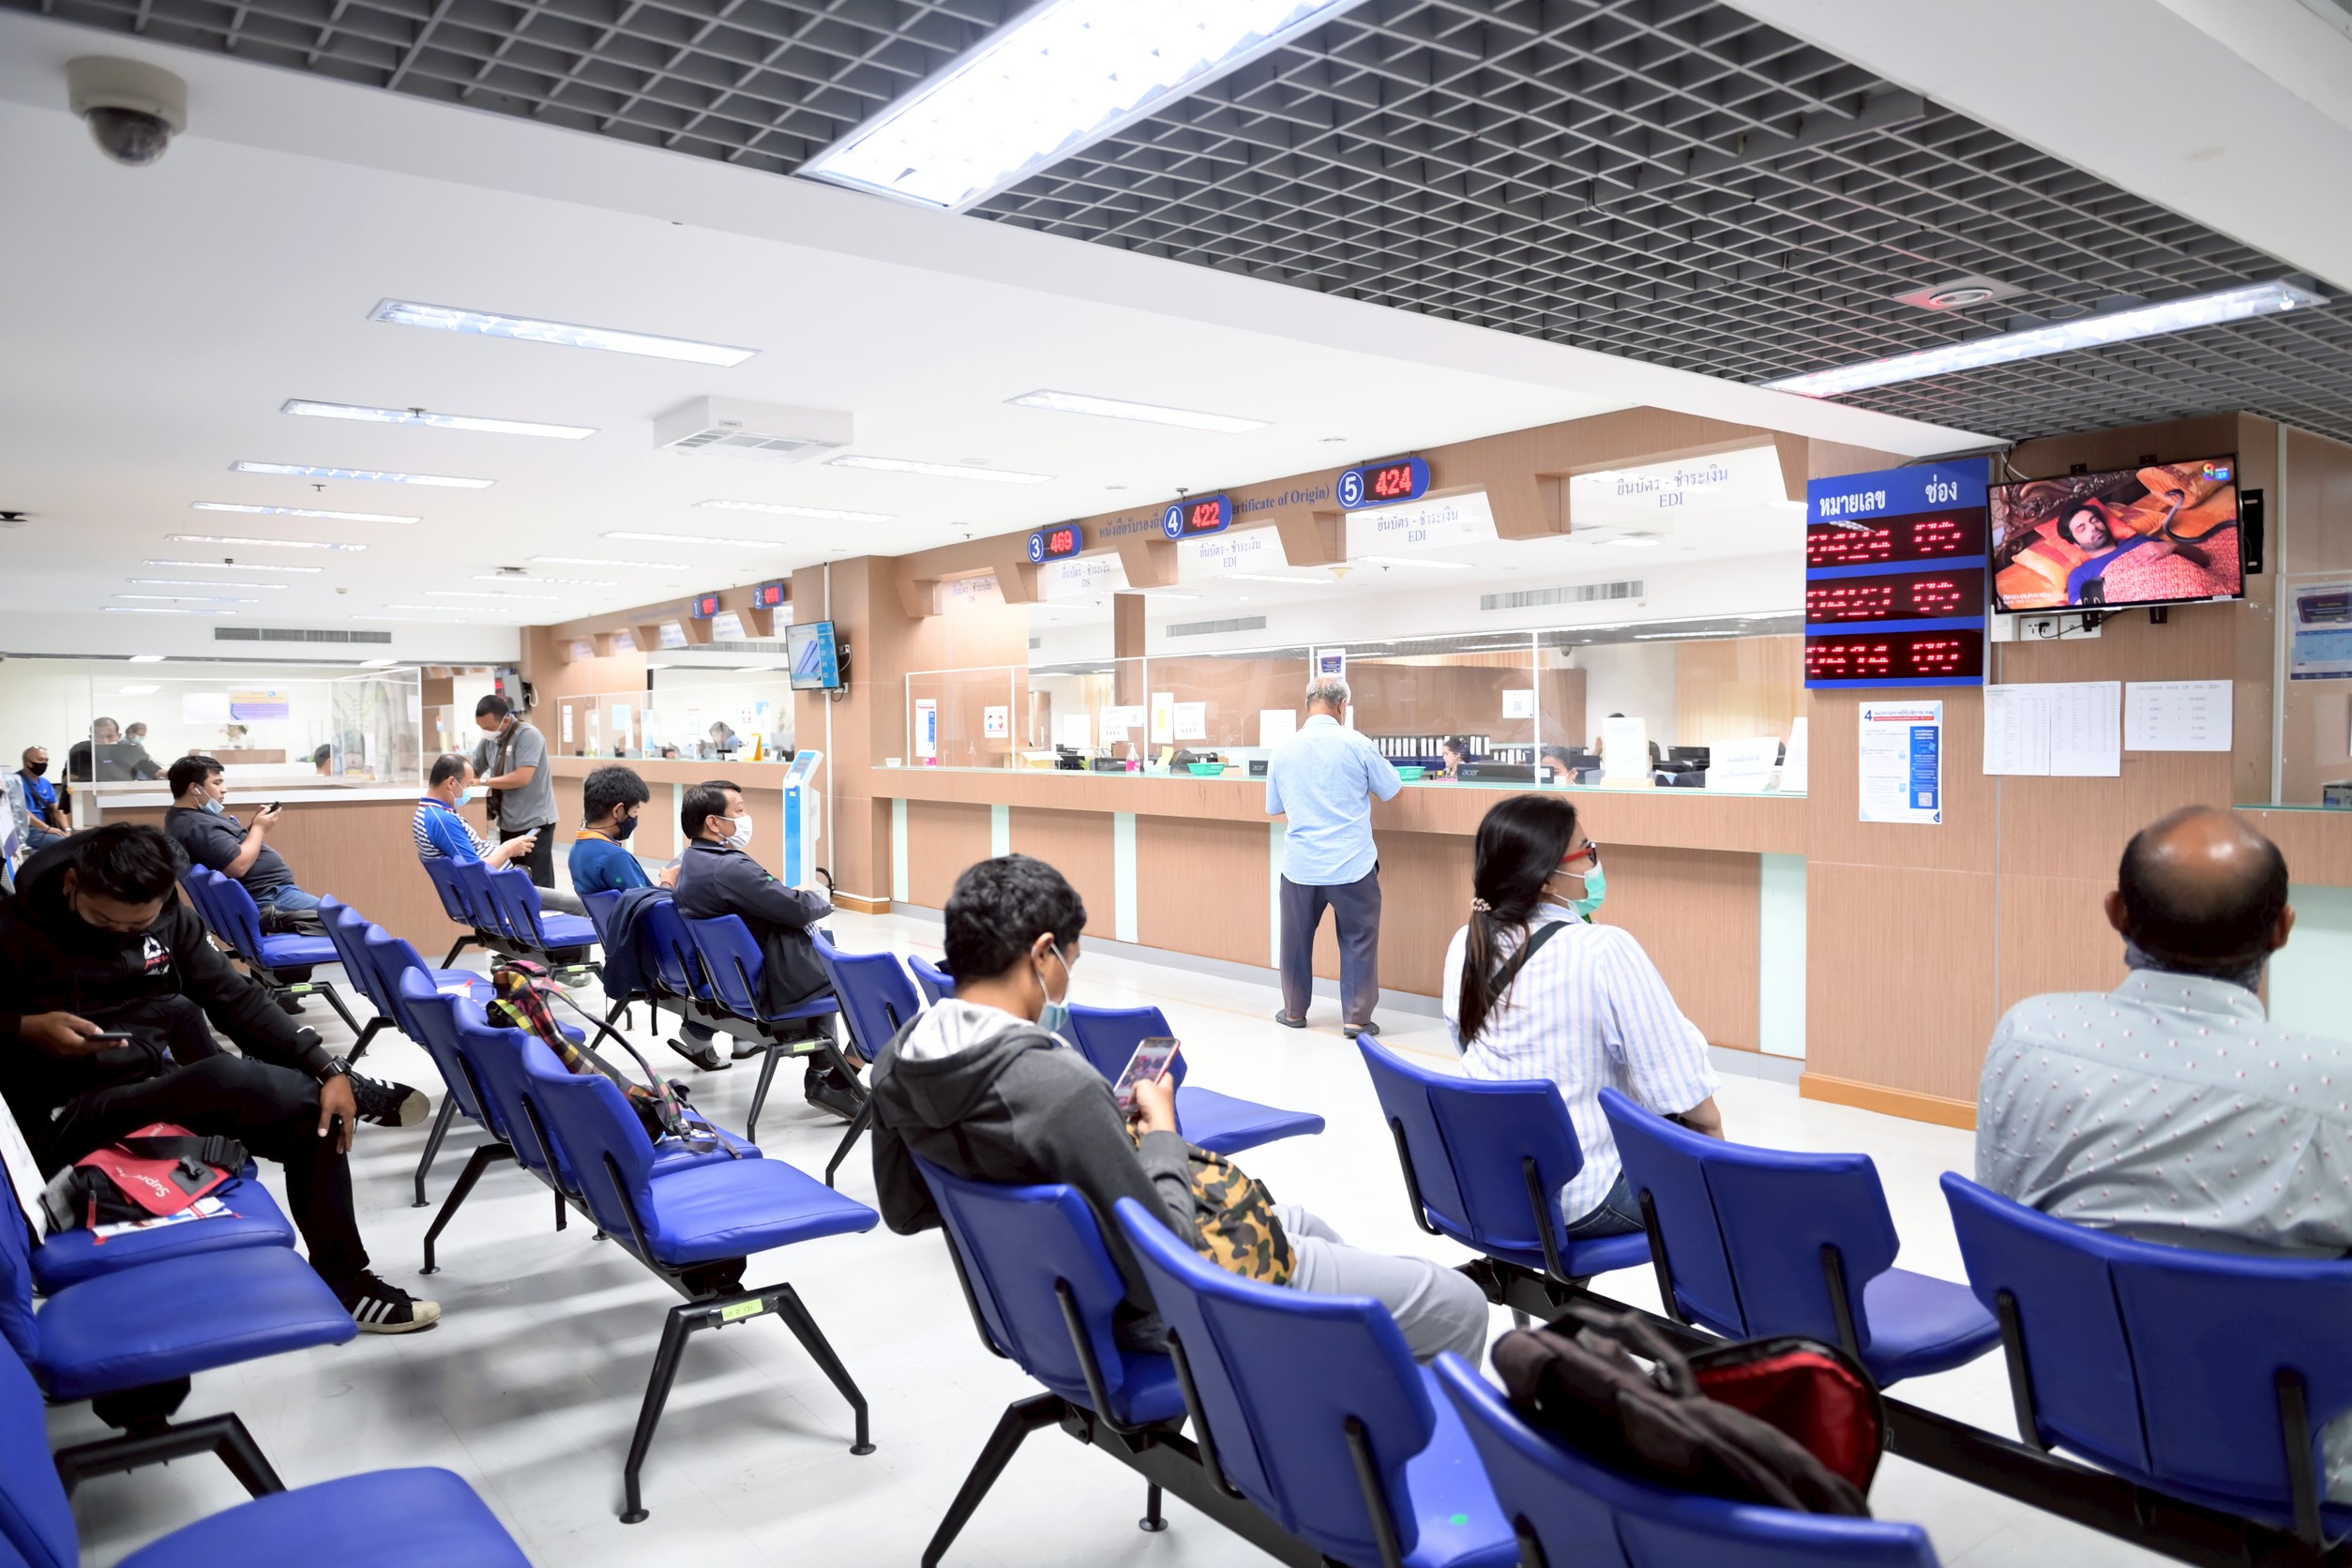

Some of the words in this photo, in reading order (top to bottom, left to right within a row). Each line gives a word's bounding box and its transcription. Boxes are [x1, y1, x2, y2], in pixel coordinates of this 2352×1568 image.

[1375, 466, 1412, 496] 424
[1674, 463, 1728, 487] ชำระเงิน
[1232, 497, 1275, 515] ertificate
[1277, 491, 1289, 506] of
[1290, 485, 1330, 505] Origin)
[1345, 475, 1358, 502] 5
[1659, 492, 1683, 507] EDI
[1925, 474, 1958, 504] ช่อง
[1192, 502, 1220, 527] 422
[1819, 490, 1887, 516] หมายเลข
[1099, 507, 1164, 538] หนังสือรับรองถิ่
[1168, 510, 1179, 533] 4
[1420, 505, 1458, 525] ชำระเงิน
[1032, 537, 1041, 558] 3
[1050, 530, 1074, 553] 469
[1408, 530, 1426, 542] EDI
[1223, 557, 1237, 568] EDI
[755, 591, 761, 606] 2
[1864, 709, 1873, 722] 4
